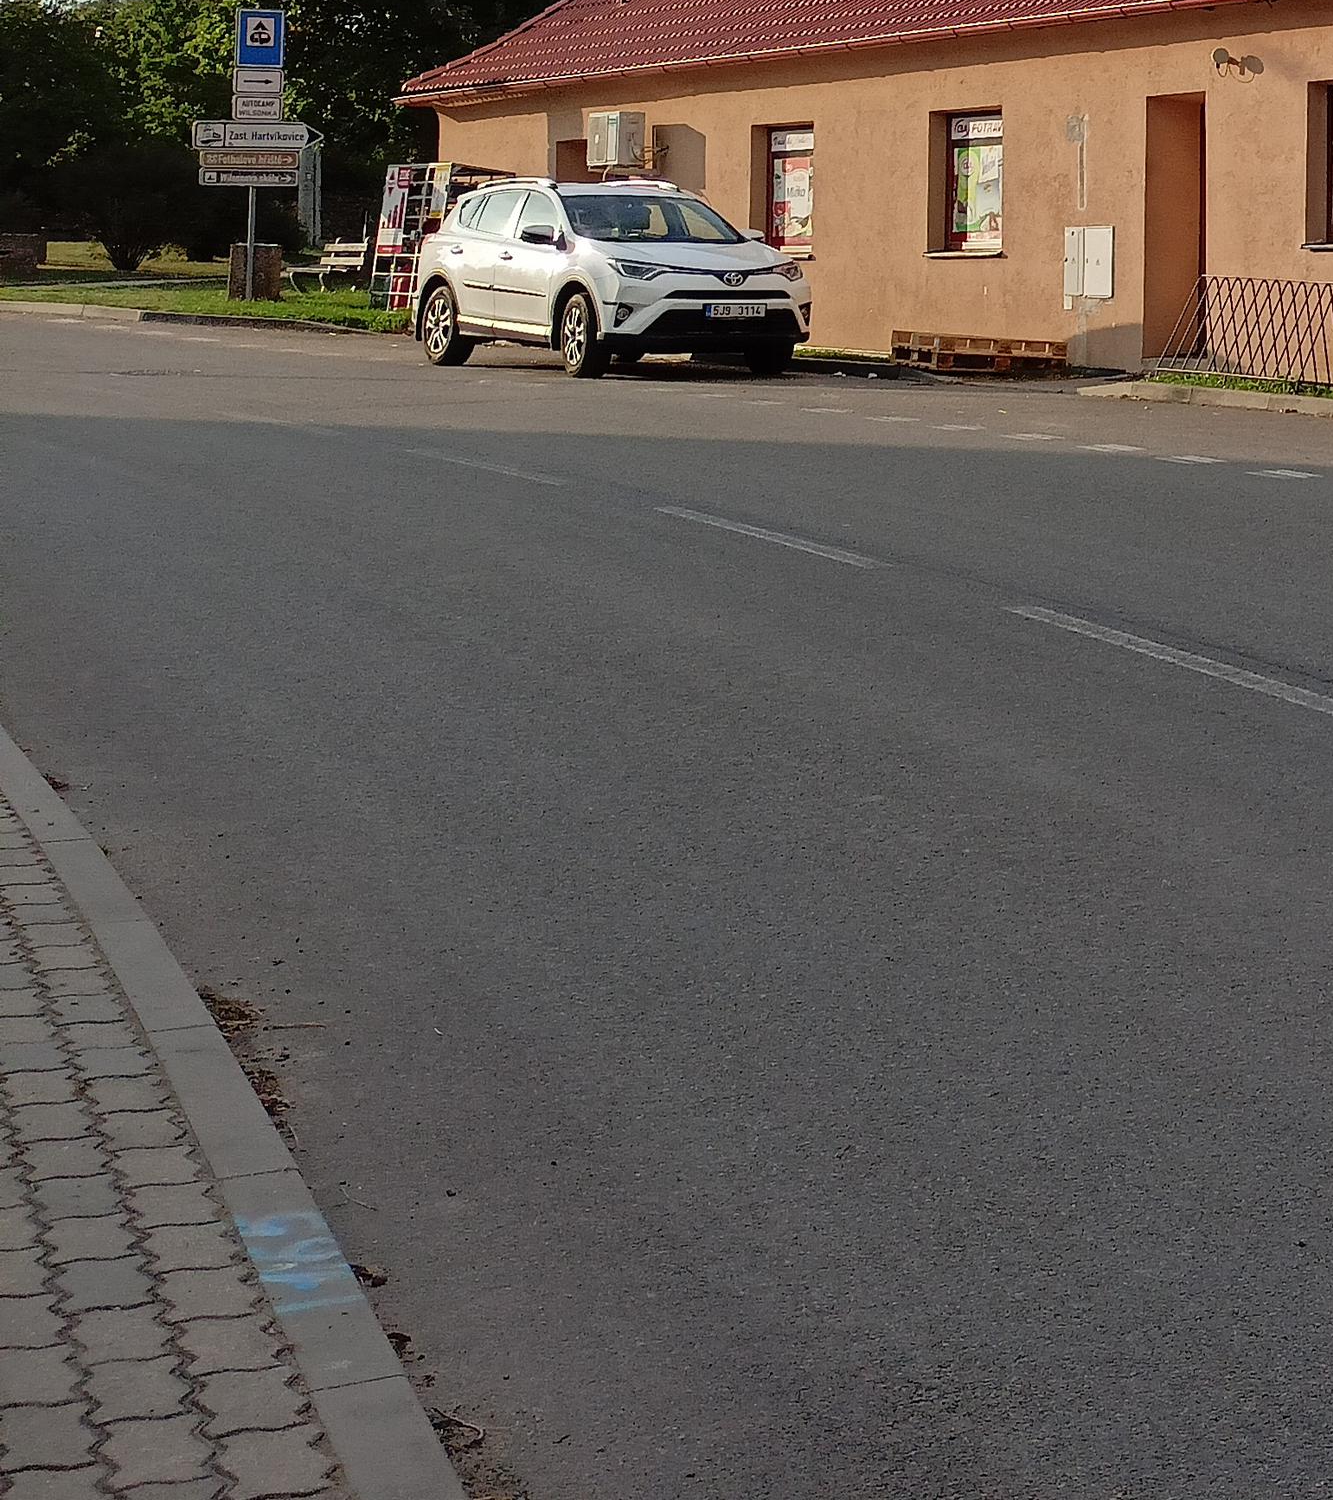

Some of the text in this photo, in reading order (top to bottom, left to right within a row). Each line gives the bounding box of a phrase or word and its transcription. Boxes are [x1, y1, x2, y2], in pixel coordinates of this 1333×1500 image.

[241, 99, 275, 108] AUTOCAMP
[239, 109, 278, 117] WILSONKA
[229, 130, 305, 141] Zast. Hartvíkovice
[713, 305, 761, 316] 5J9 3114
